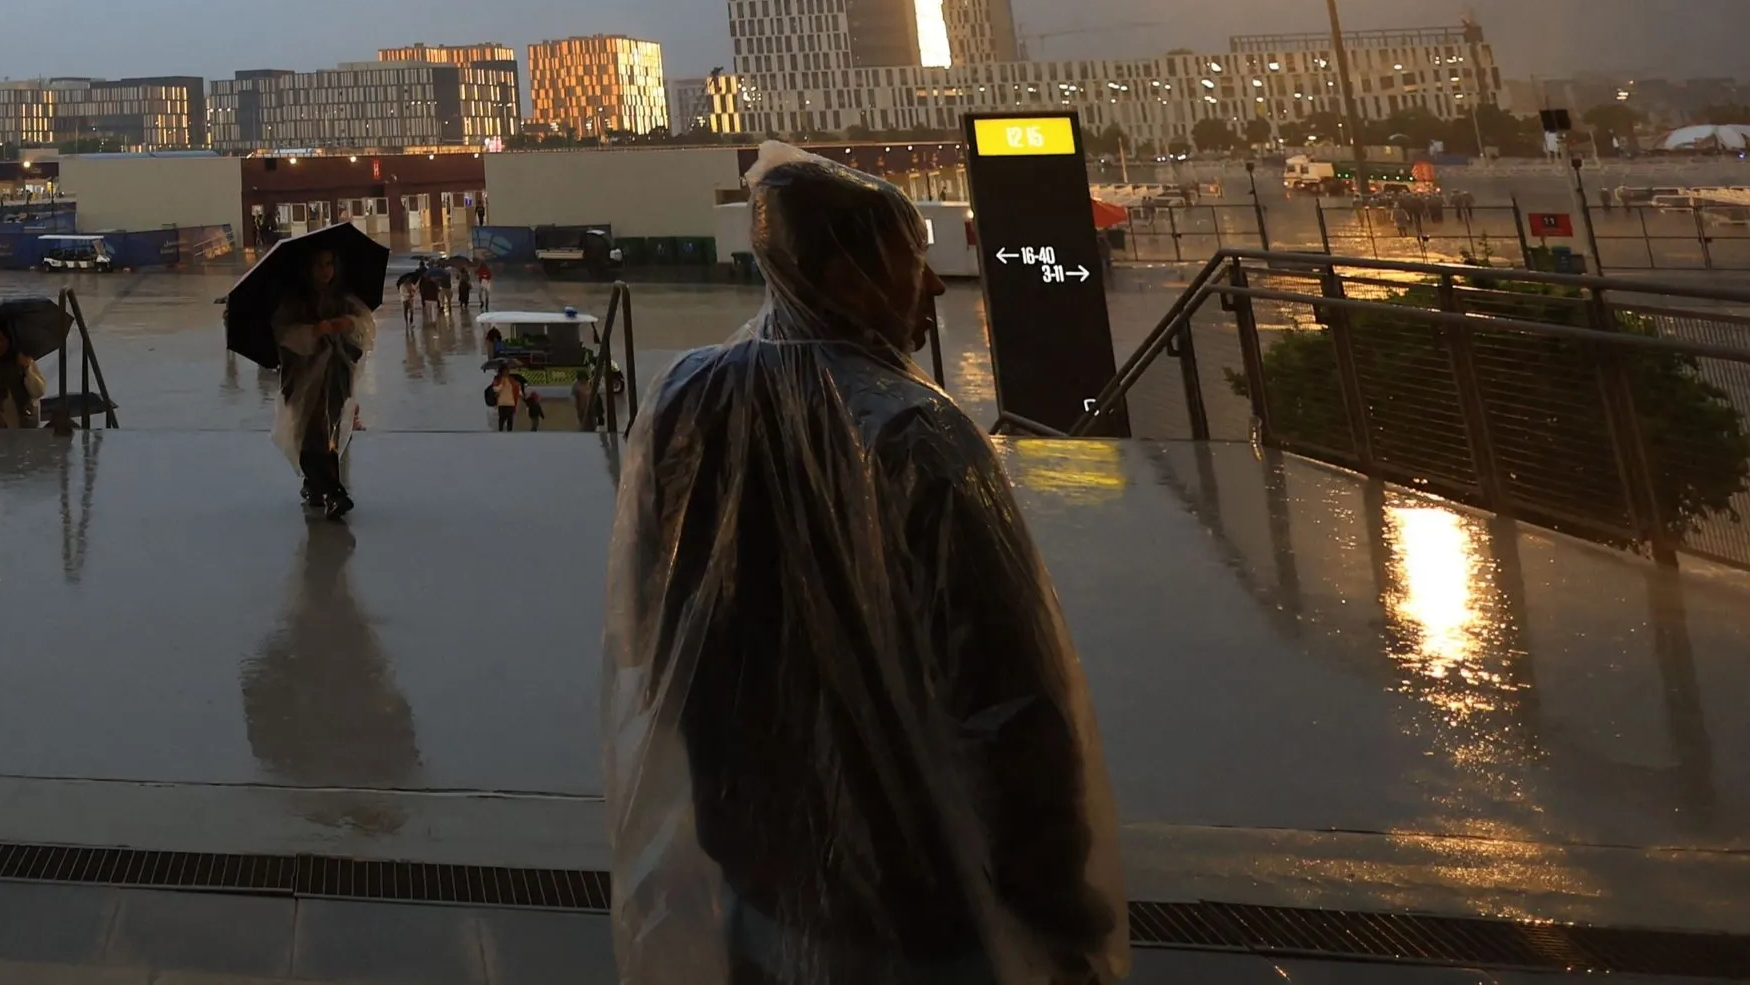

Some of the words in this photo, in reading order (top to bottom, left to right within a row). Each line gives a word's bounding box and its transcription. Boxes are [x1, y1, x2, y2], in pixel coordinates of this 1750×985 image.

[1006, 126, 1024, 148] 12
[1025, 126, 1045, 148] 15
[1020, 246, 1056, 265] 16-40
[1041, 264, 1065, 283] 3-11
